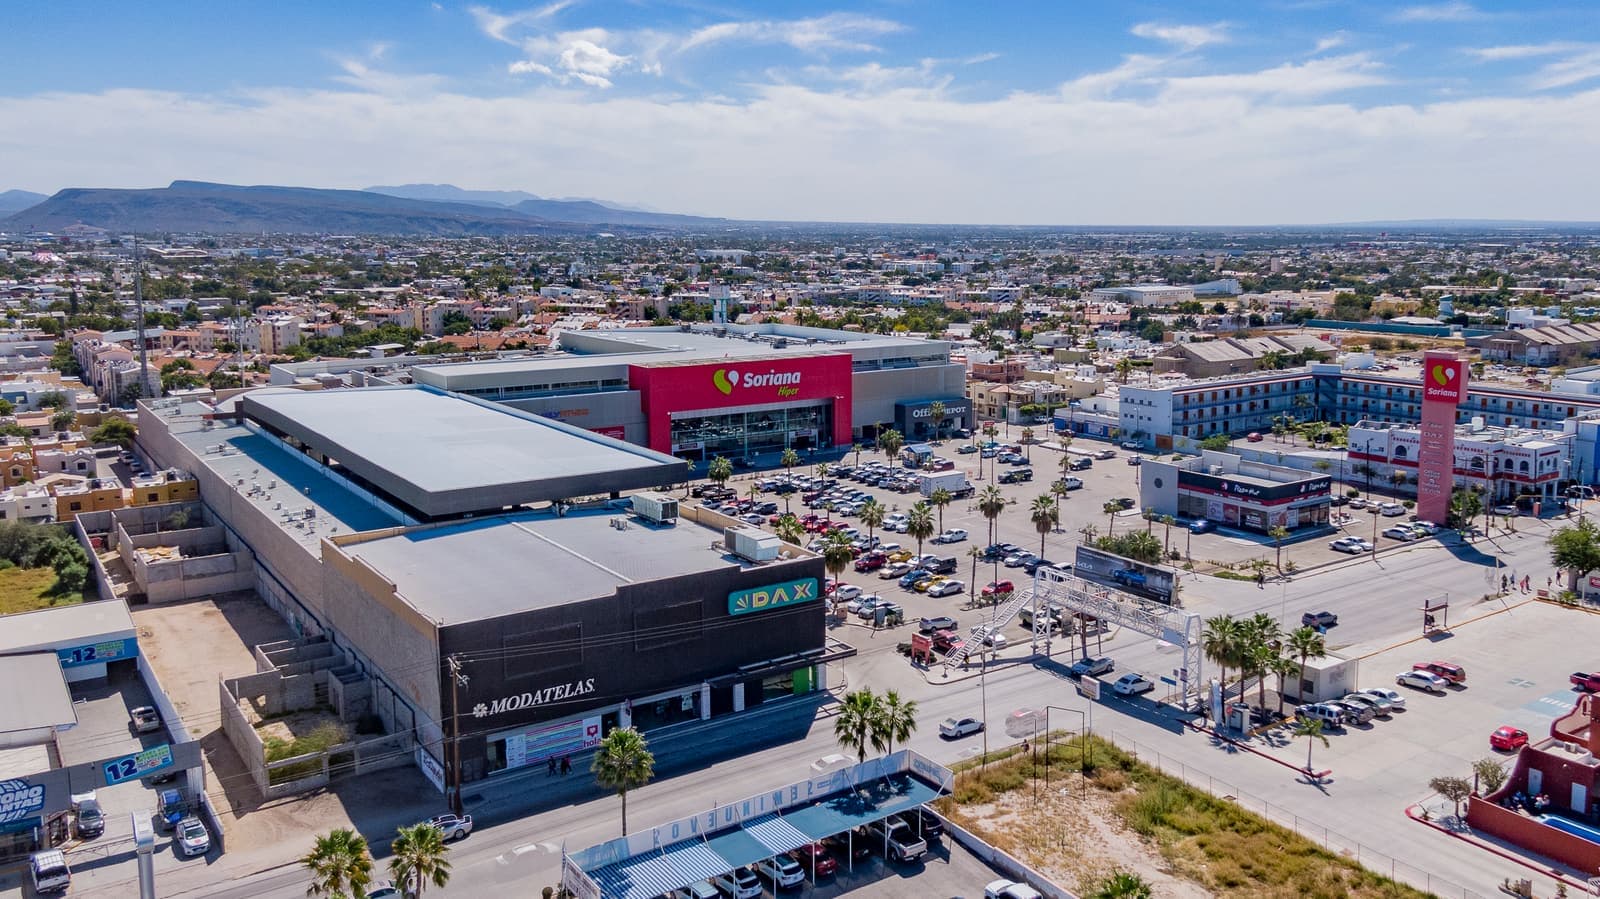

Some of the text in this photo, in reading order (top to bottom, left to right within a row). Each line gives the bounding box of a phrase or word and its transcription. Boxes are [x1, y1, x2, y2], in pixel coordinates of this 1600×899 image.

[743, 369, 801, 388] Soriana
[777, 386, 800, 397] Hiper
[1427, 387, 1458, 398] Soriana
[752, 582, 812, 608] DAX
[72, 647, 96, 662] 12
[489, 678, 595, 715] MODATELAS
[583, 736, 602, 748] hola
[107, 759, 138, 780] 12
